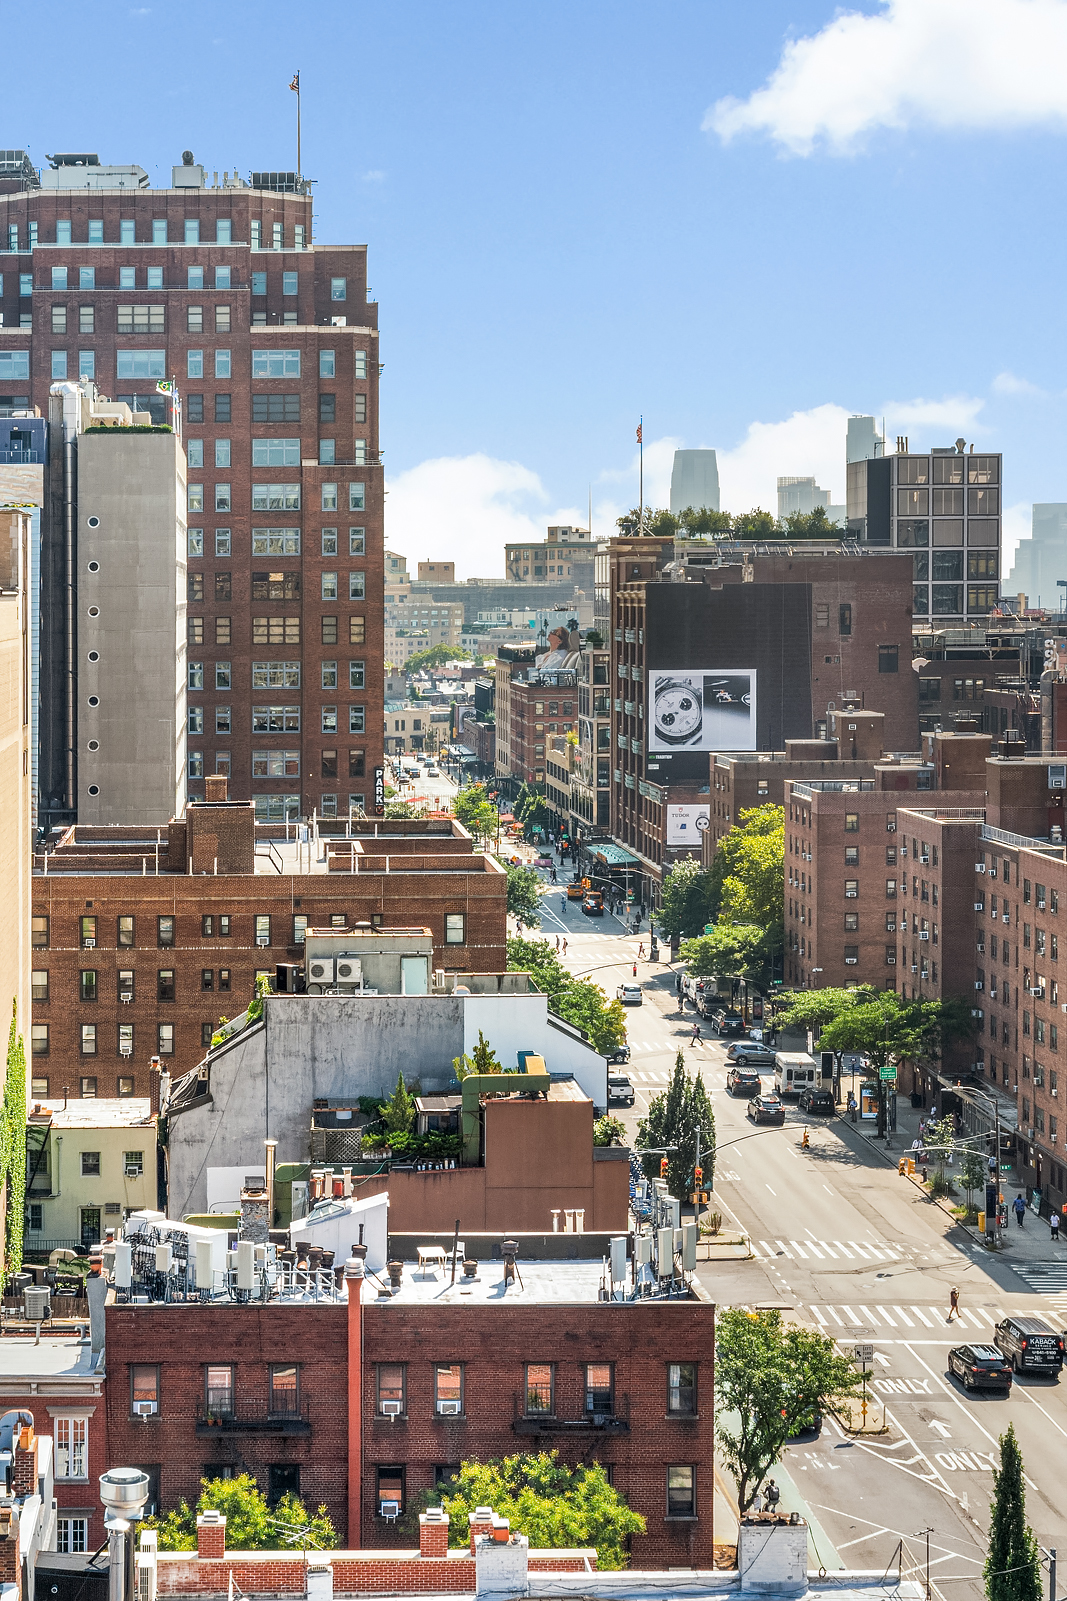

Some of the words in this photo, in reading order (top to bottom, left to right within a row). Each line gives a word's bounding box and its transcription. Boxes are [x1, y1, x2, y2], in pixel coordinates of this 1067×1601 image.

[537, 612, 578, 620] GUCCI
[874, 1379, 933, 1395] ONLY
[935, 1452, 1003, 1471] ONLY
